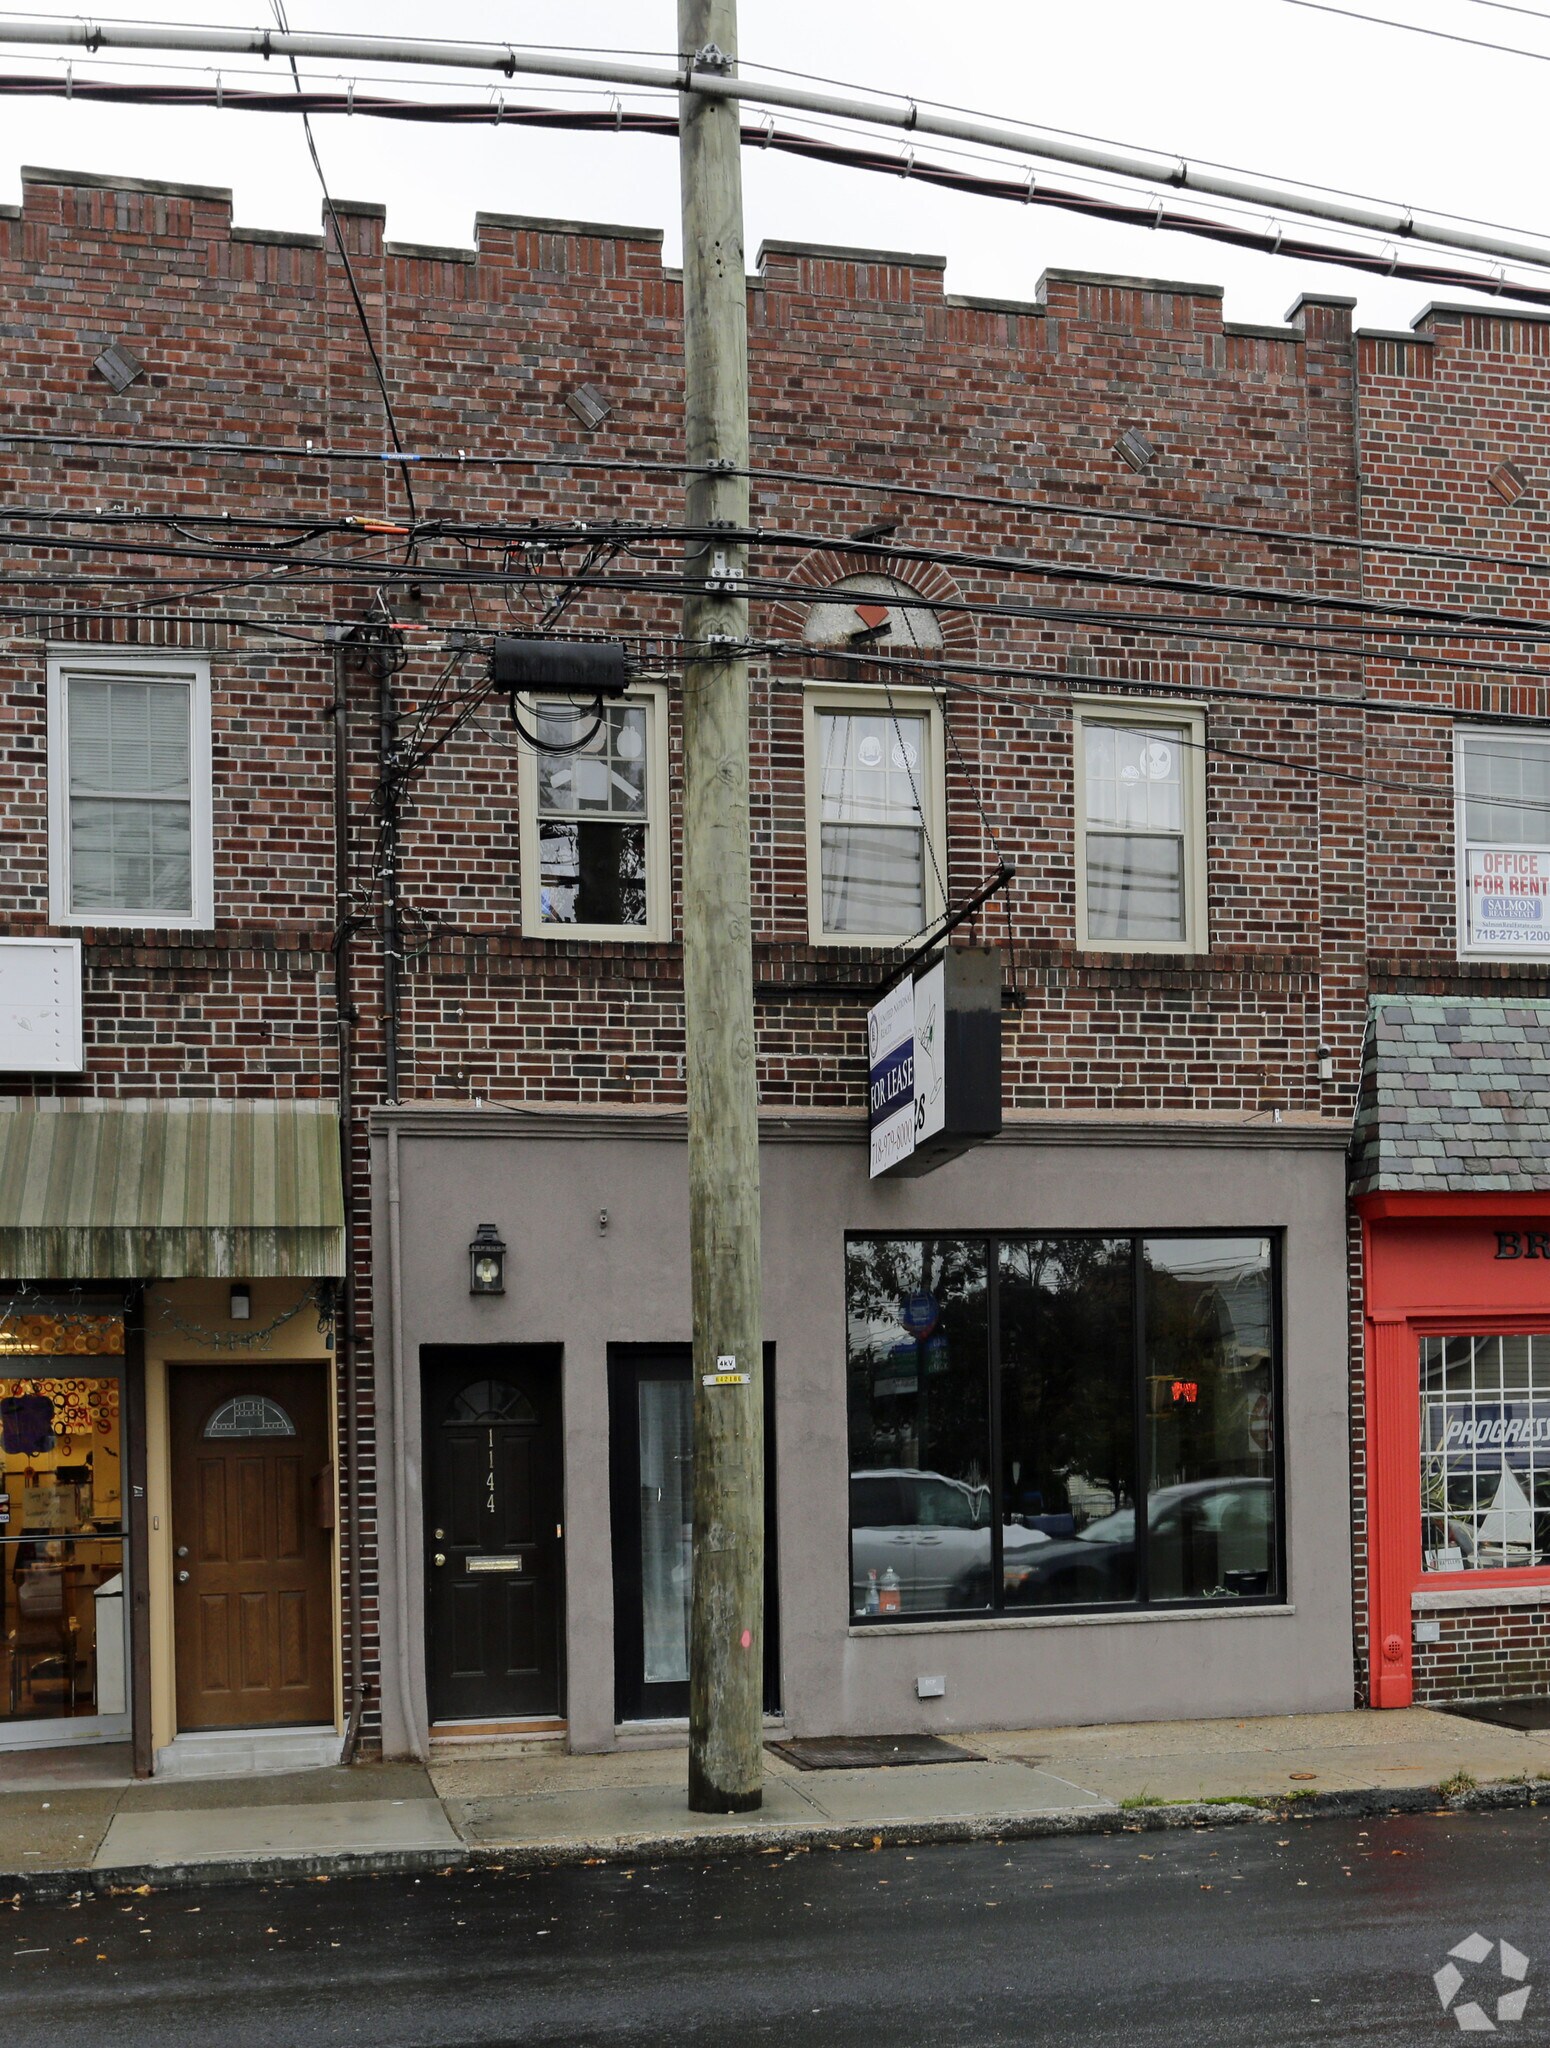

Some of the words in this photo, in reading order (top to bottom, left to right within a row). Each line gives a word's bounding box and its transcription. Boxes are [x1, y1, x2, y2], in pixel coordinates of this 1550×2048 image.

[1483, 852, 1538, 875] OFFICE
[1474, 875, 1505, 895] FOR
[1509, 876, 1550, 896] RENT
[1488, 899, 1536, 911] SALMON
[1475, 929, 1550, 941] 718-273-1200
[870, 1077, 887, 1114] FOR
[887, 1056, 914, 1101] LEASE
[1494, 1231, 1550, 1259] BR
[719, 1359, 733, 1367] 4kV
[486, 1428, 495, 1513] 1144
